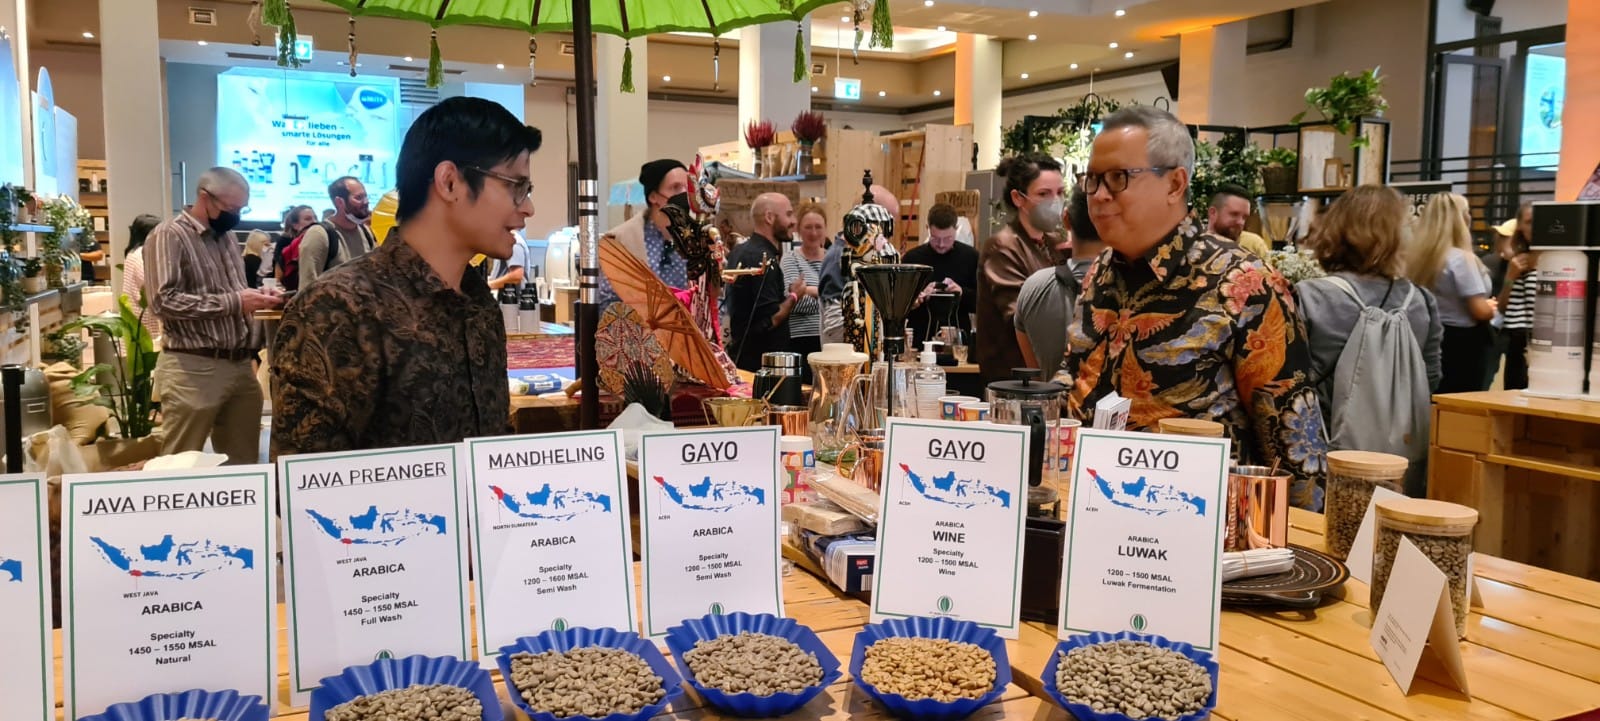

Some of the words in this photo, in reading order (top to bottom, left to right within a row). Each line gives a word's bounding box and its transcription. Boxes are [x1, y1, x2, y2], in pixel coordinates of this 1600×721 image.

[309, 121, 337, 130] lieben
[312, 132, 351, 141] Lösungen
[681, 440, 738, 463] GAYO
[928, 438, 985, 461] GAYO
[488, 446, 605, 469] MANDHELING
[1117, 447, 1180, 470] GAYO
[297, 472, 344, 490] JAVA
[350, 461, 447, 485] PREANGER
[82, 496, 137, 516] JAVA
[143, 488, 257, 511] PREANGER
[935, 520, 965, 529] ARABICA
[692, 526, 734, 538] ARABICA
[932, 530, 966, 544] WINE
[530, 535, 576, 548] ARABICA
[1127, 535, 1160, 545] ARABICA
[698, 551, 729, 562] Specialty
[933, 547, 965, 558] Specialty
[1118, 545, 1168, 561] LUWAK
[336, 557, 352, 565] WEST
[684, 564, 700, 573] 1200
[707, 562, 723, 570] 1500
[723, 560, 743, 568] MSAL
[917, 556, 933, 564] 1200
[941, 558, 957, 567] 1500
[958, 560, 979, 569] MSAL
[352, 562, 406, 578] ARABICA
[539, 563, 573, 574] Specialty
[938, 567, 956, 577] Wine
[523, 577, 541, 586] 1200
[549, 574, 566, 583] 1600
[567, 571, 589, 581] MSAL
[695, 573, 713, 582] Semi
[714, 571, 732, 579] Wash
[1106, 568, 1124, 578] 1200
[1132, 572, 1149, 580] 1500
[1150, 574, 1173, 583] MSAL
[536, 586, 556, 595] Semi
[557, 583, 577, 593] Wash
[1102, 578, 1126, 588] Luwak
[1127, 581, 1177, 594] Fermentation
[123, 591, 141, 599] WEST
[142, 590, 159, 598] JAVA
[361, 591, 400, 604] Specialty
[141, 600, 204, 616] ARABICA
[342, 607, 363, 617] 1450
[372, 603, 393, 614] 1550
[394, 599, 419, 610] MSAL
[361, 616, 377, 626] Full
[378, 613, 403, 624] Wash
[150, 629, 196, 643] Specialty
[128, 645, 152, 656] 1450
[163, 642, 186, 652] 1550
[188, 639, 217, 650] MSAL
[155, 654, 192, 665] Natural
